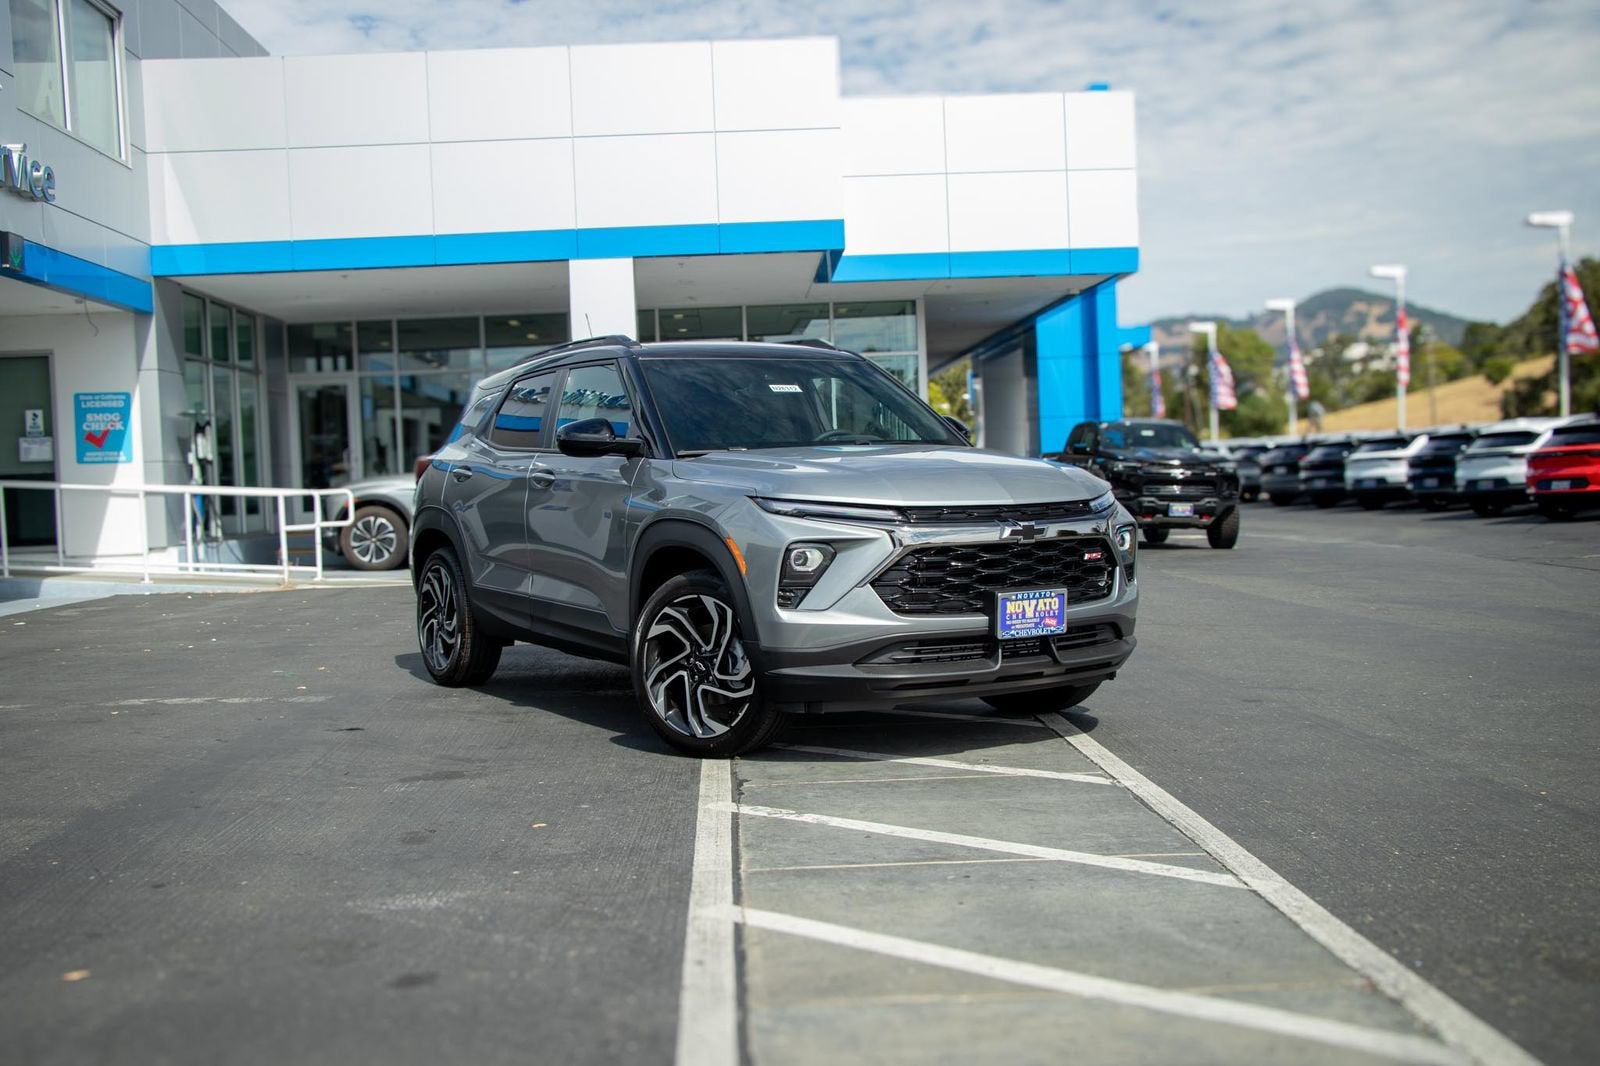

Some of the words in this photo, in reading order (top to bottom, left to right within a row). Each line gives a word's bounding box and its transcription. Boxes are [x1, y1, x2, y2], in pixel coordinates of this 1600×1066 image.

[81, 400, 125, 408] LICENSED
[86, 412, 121, 421] SMOG
[82, 421, 125, 430] CHECK
[1017, 591, 1051, 599] NOVATO
[1006, 597, 1059, 618] NOVATO
[1014, 628, 1052, 637] CHEVROLET
